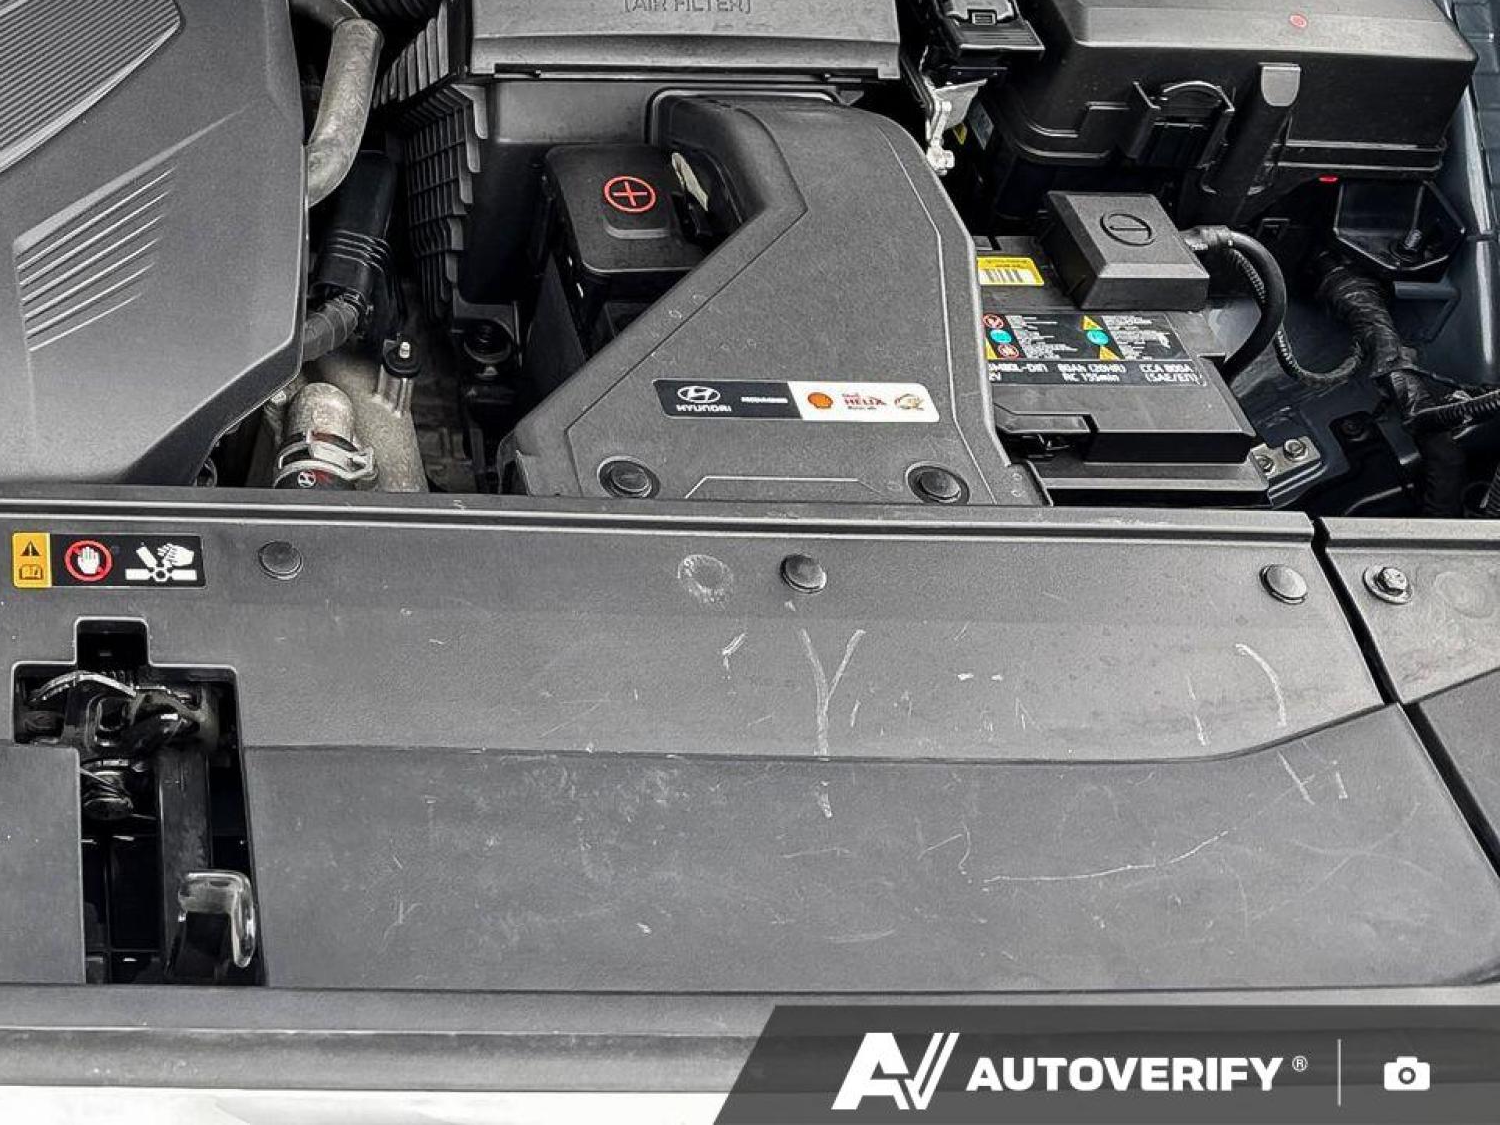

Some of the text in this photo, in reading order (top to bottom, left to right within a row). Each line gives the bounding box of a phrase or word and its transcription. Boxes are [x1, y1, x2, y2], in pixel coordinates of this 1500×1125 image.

[1139, 363, 1164, 373] CCA
[988, 372, 1002, 382] 2V
[675, 404, 732, 412] HYUNDAI
